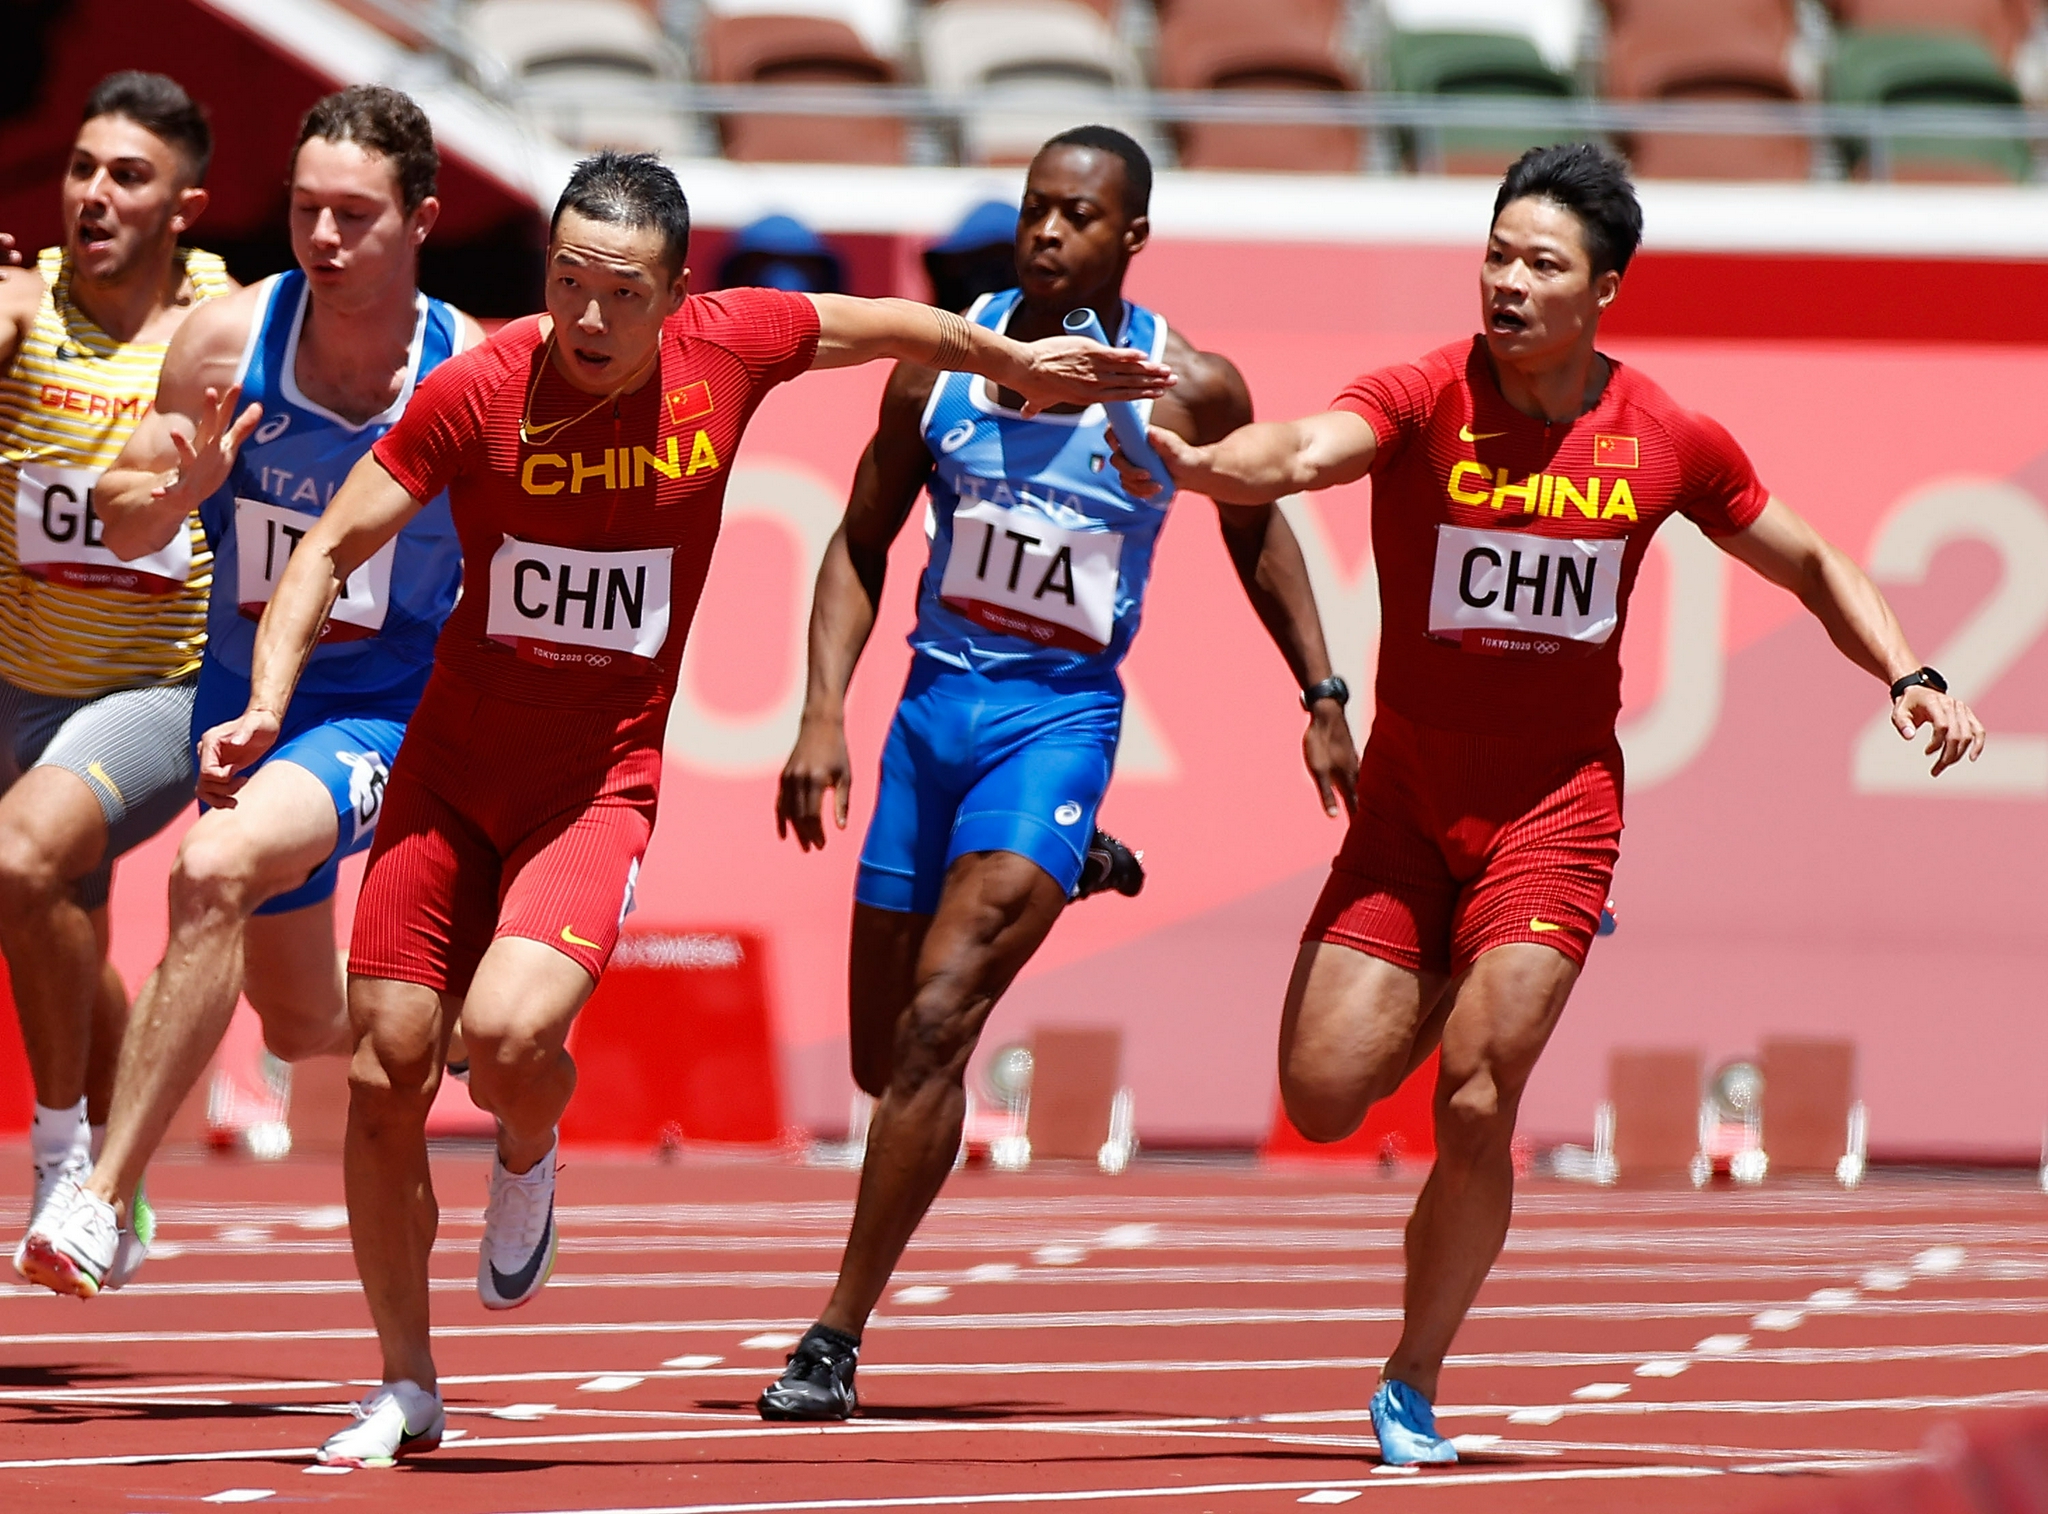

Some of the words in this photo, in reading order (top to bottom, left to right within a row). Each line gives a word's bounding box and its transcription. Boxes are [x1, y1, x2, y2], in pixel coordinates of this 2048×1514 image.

[521, 430, 720, 495] CHINA
[1447, 460, 1639, 522] CHINA
[42, 484, 105, 547] GE
[265, 519, 349, 599] IT
[976, 523, 1075, 606] ITA
[1459, 547, 1598, 617] CHN
[513, 559, 646, 631] CHN
[533, 646, 560, 661] TOKYO
[560, 653, 582, 662] 2020
[1481, 637, 1509, 648] TOKYO
[1510, 640, 1531, 650] 2020
